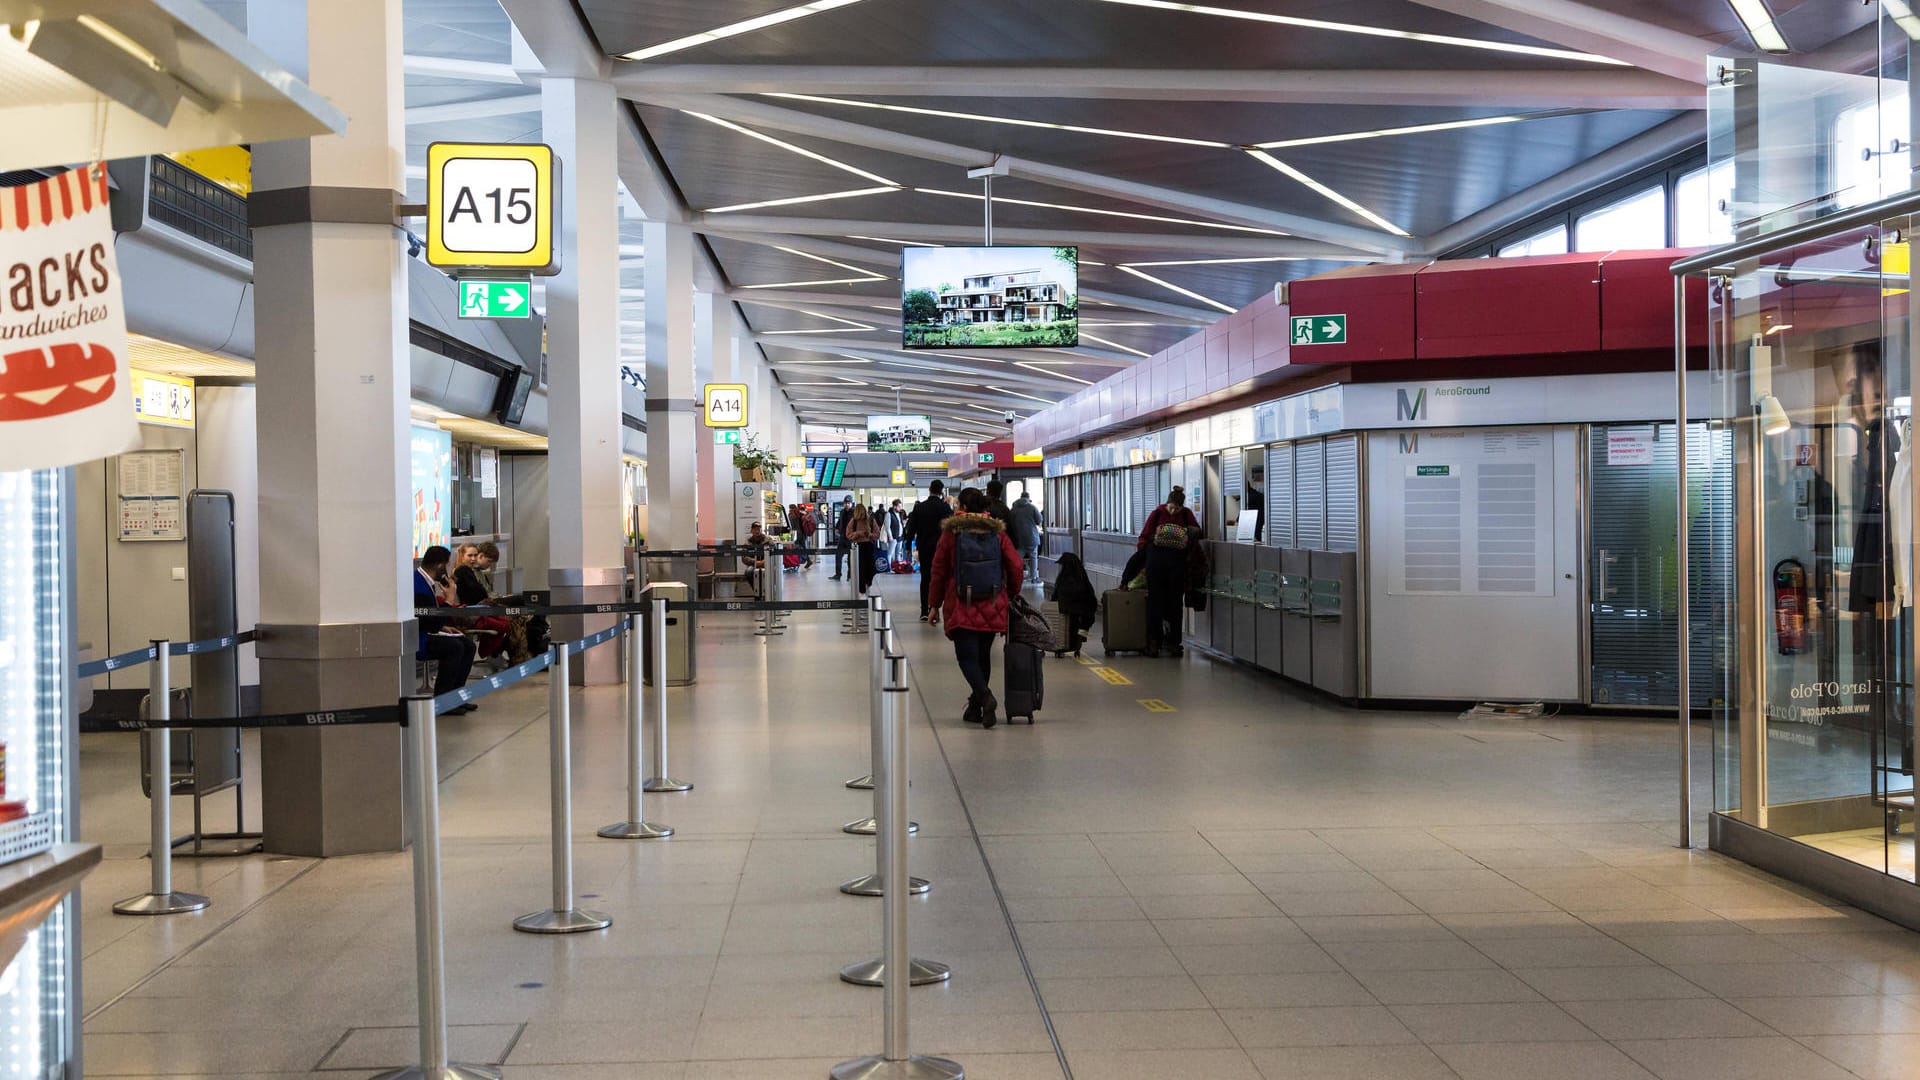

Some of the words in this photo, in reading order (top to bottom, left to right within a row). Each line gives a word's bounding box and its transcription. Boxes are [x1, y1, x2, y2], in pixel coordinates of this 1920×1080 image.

[448, 186, 532, 225] A15
[0, 242, 109, 313] acKS
[1435, 385, 1490, 396] AeroGround
[712, 399, 740, 412] A14
[726, 602, 741, 610] BER
[817, 601, 831, 609] BER
[506, 607, 520, 615] BER
[306, 712, 336, 724] BER
